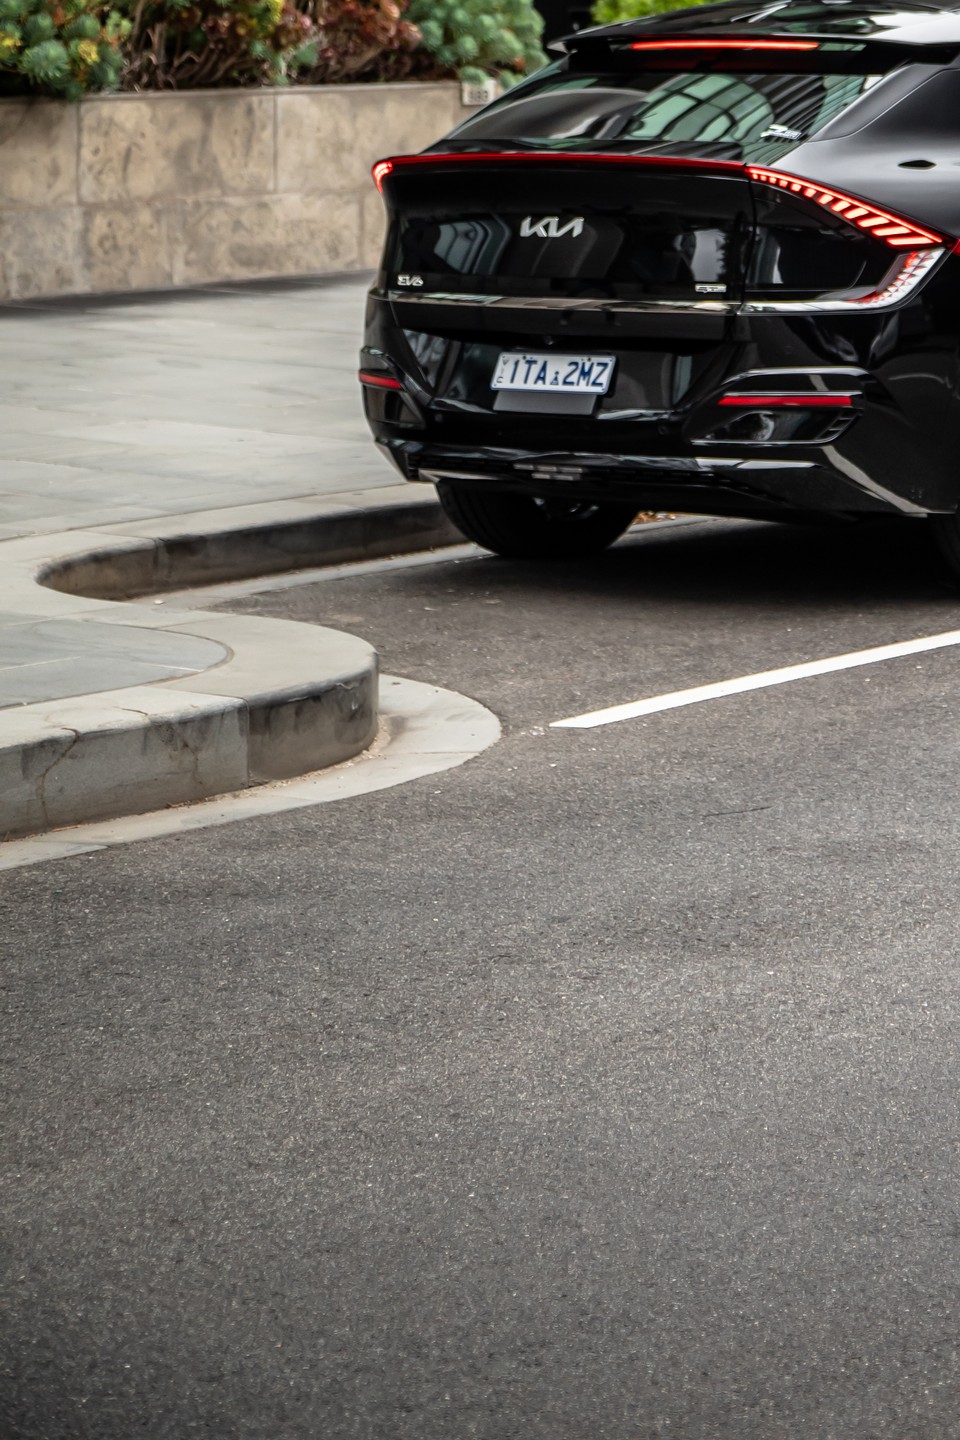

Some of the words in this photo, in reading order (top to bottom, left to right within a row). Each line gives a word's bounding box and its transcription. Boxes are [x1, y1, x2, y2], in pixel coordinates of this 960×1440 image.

[397, 274, 424, 287] EV6
[510, 359, 548, 386] 1TA
[561, 361, 609, 388] 2MZ
